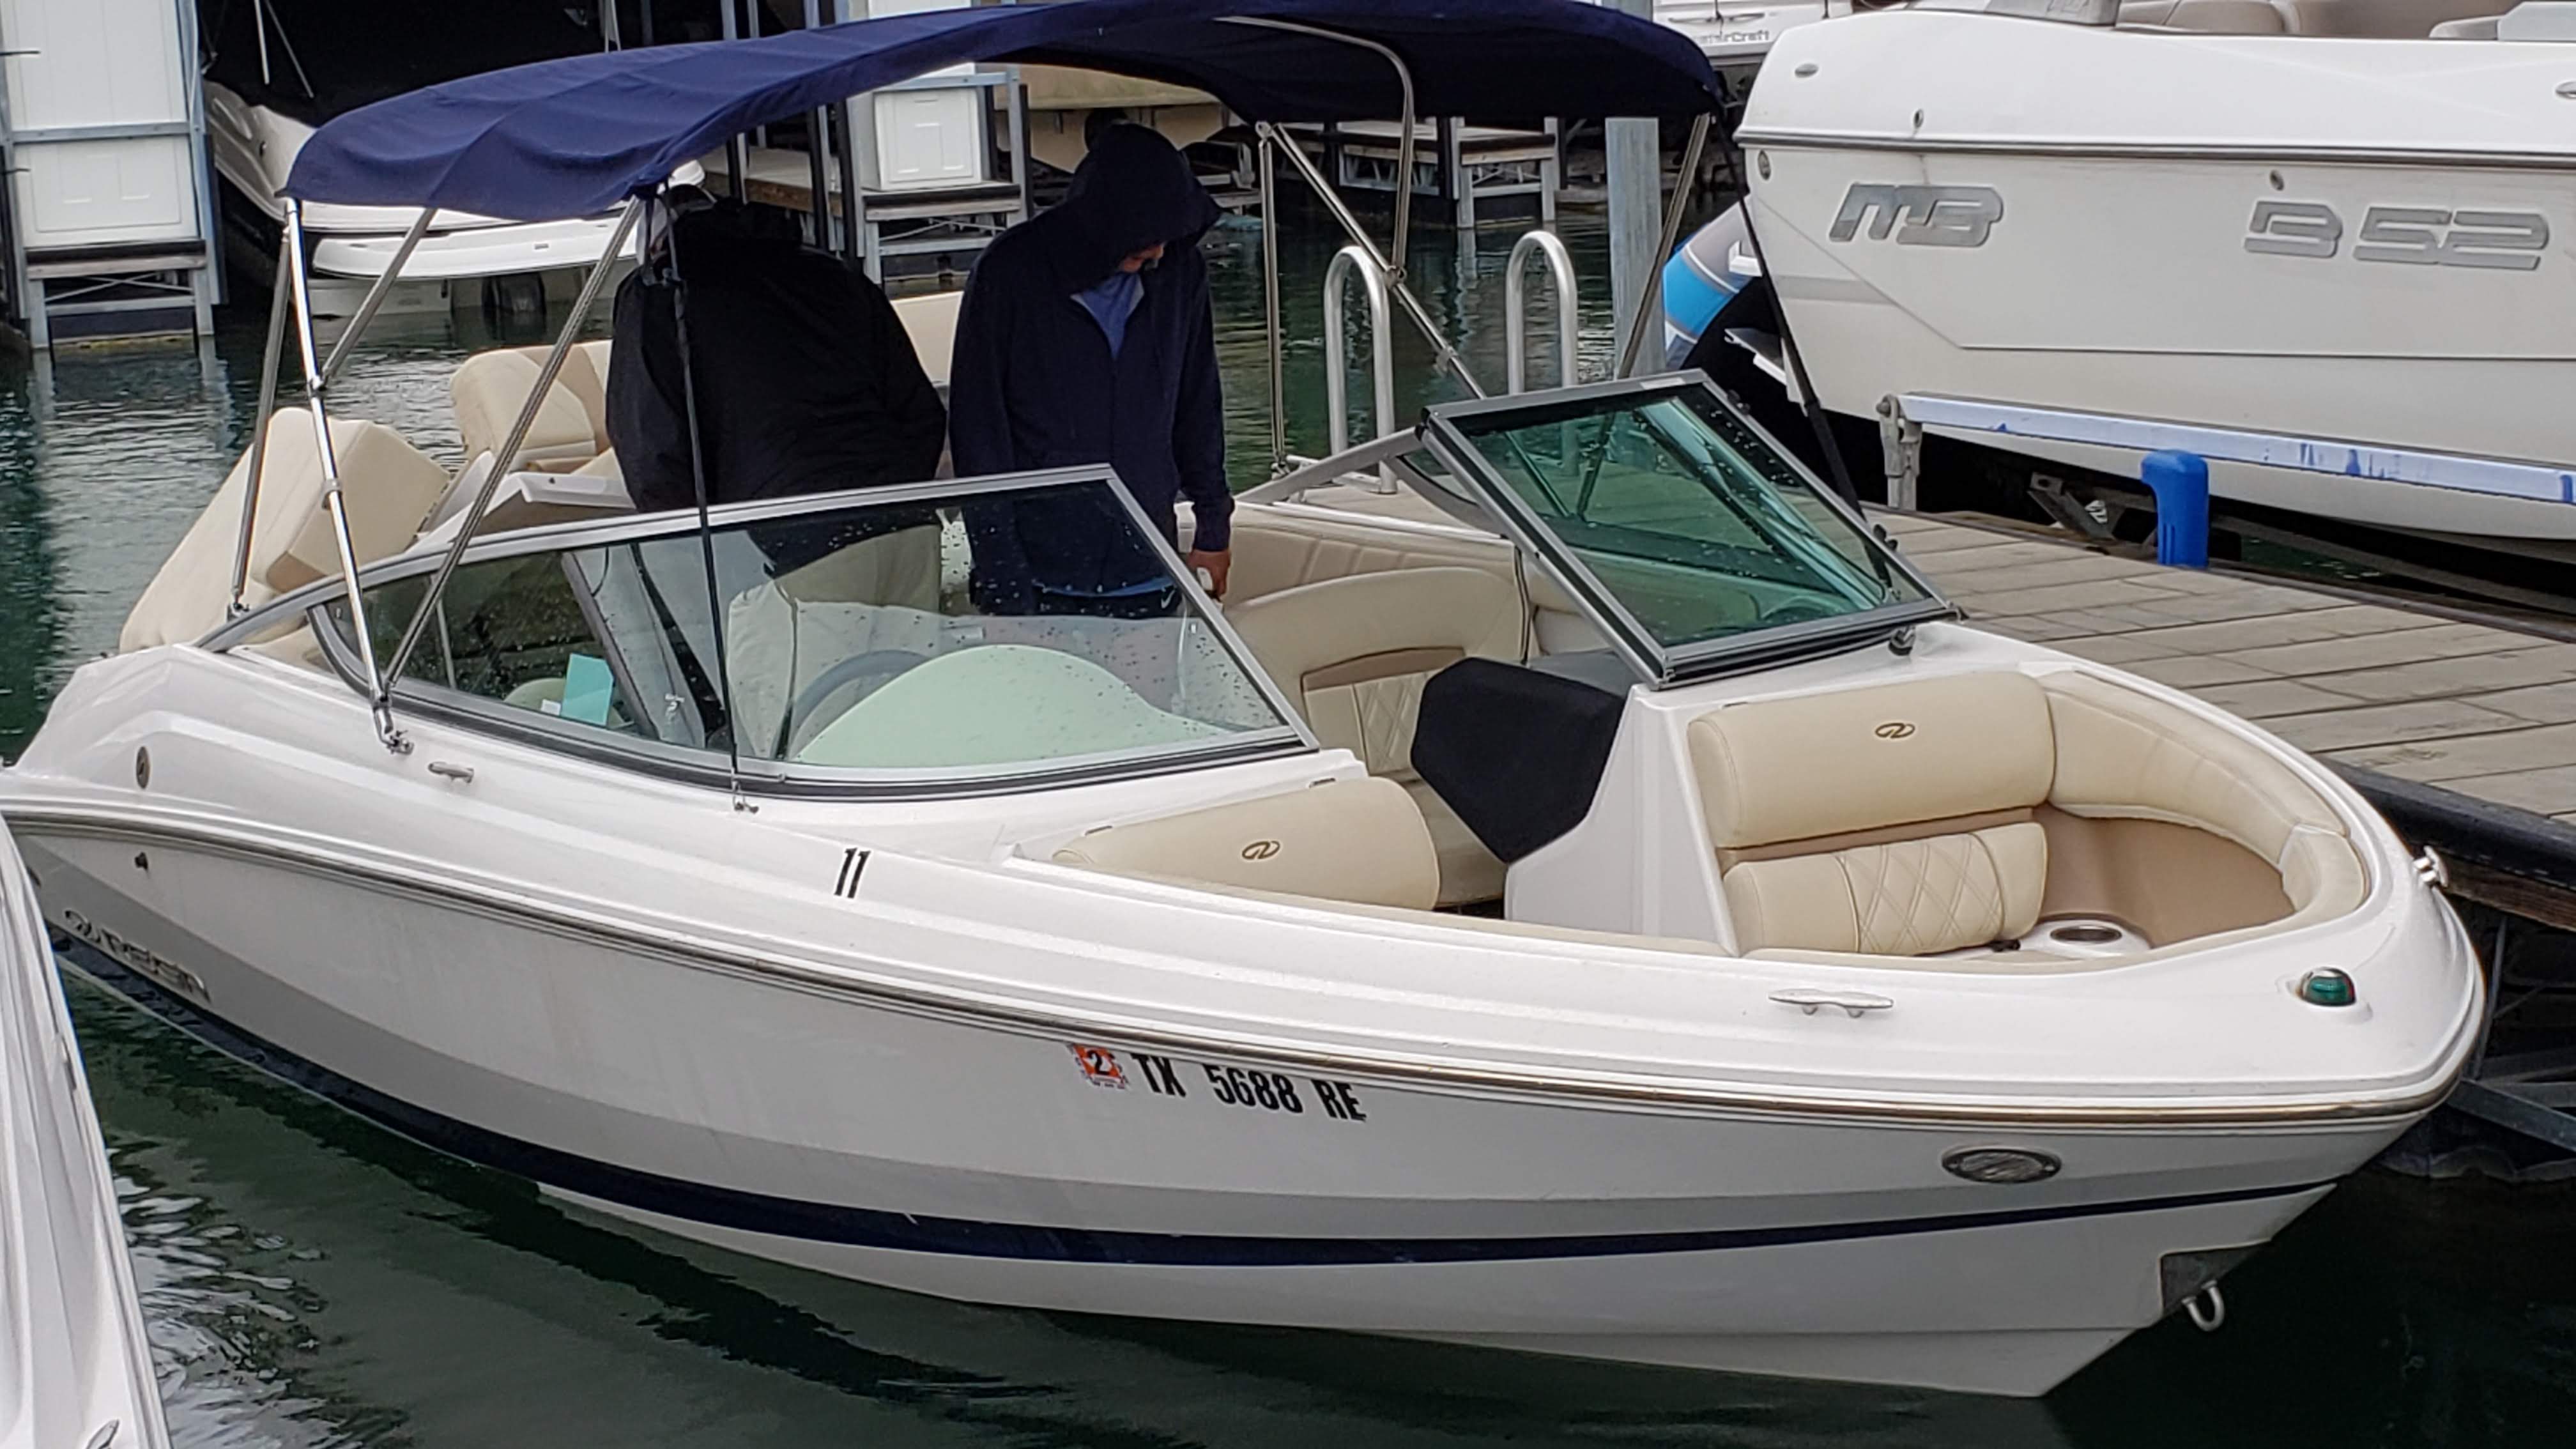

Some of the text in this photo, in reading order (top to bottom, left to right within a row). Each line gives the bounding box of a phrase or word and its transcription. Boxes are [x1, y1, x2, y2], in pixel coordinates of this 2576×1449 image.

[833, 847, 871, 899] 11
[1129, 1052, 1367, 1123] TX 5688 RE
